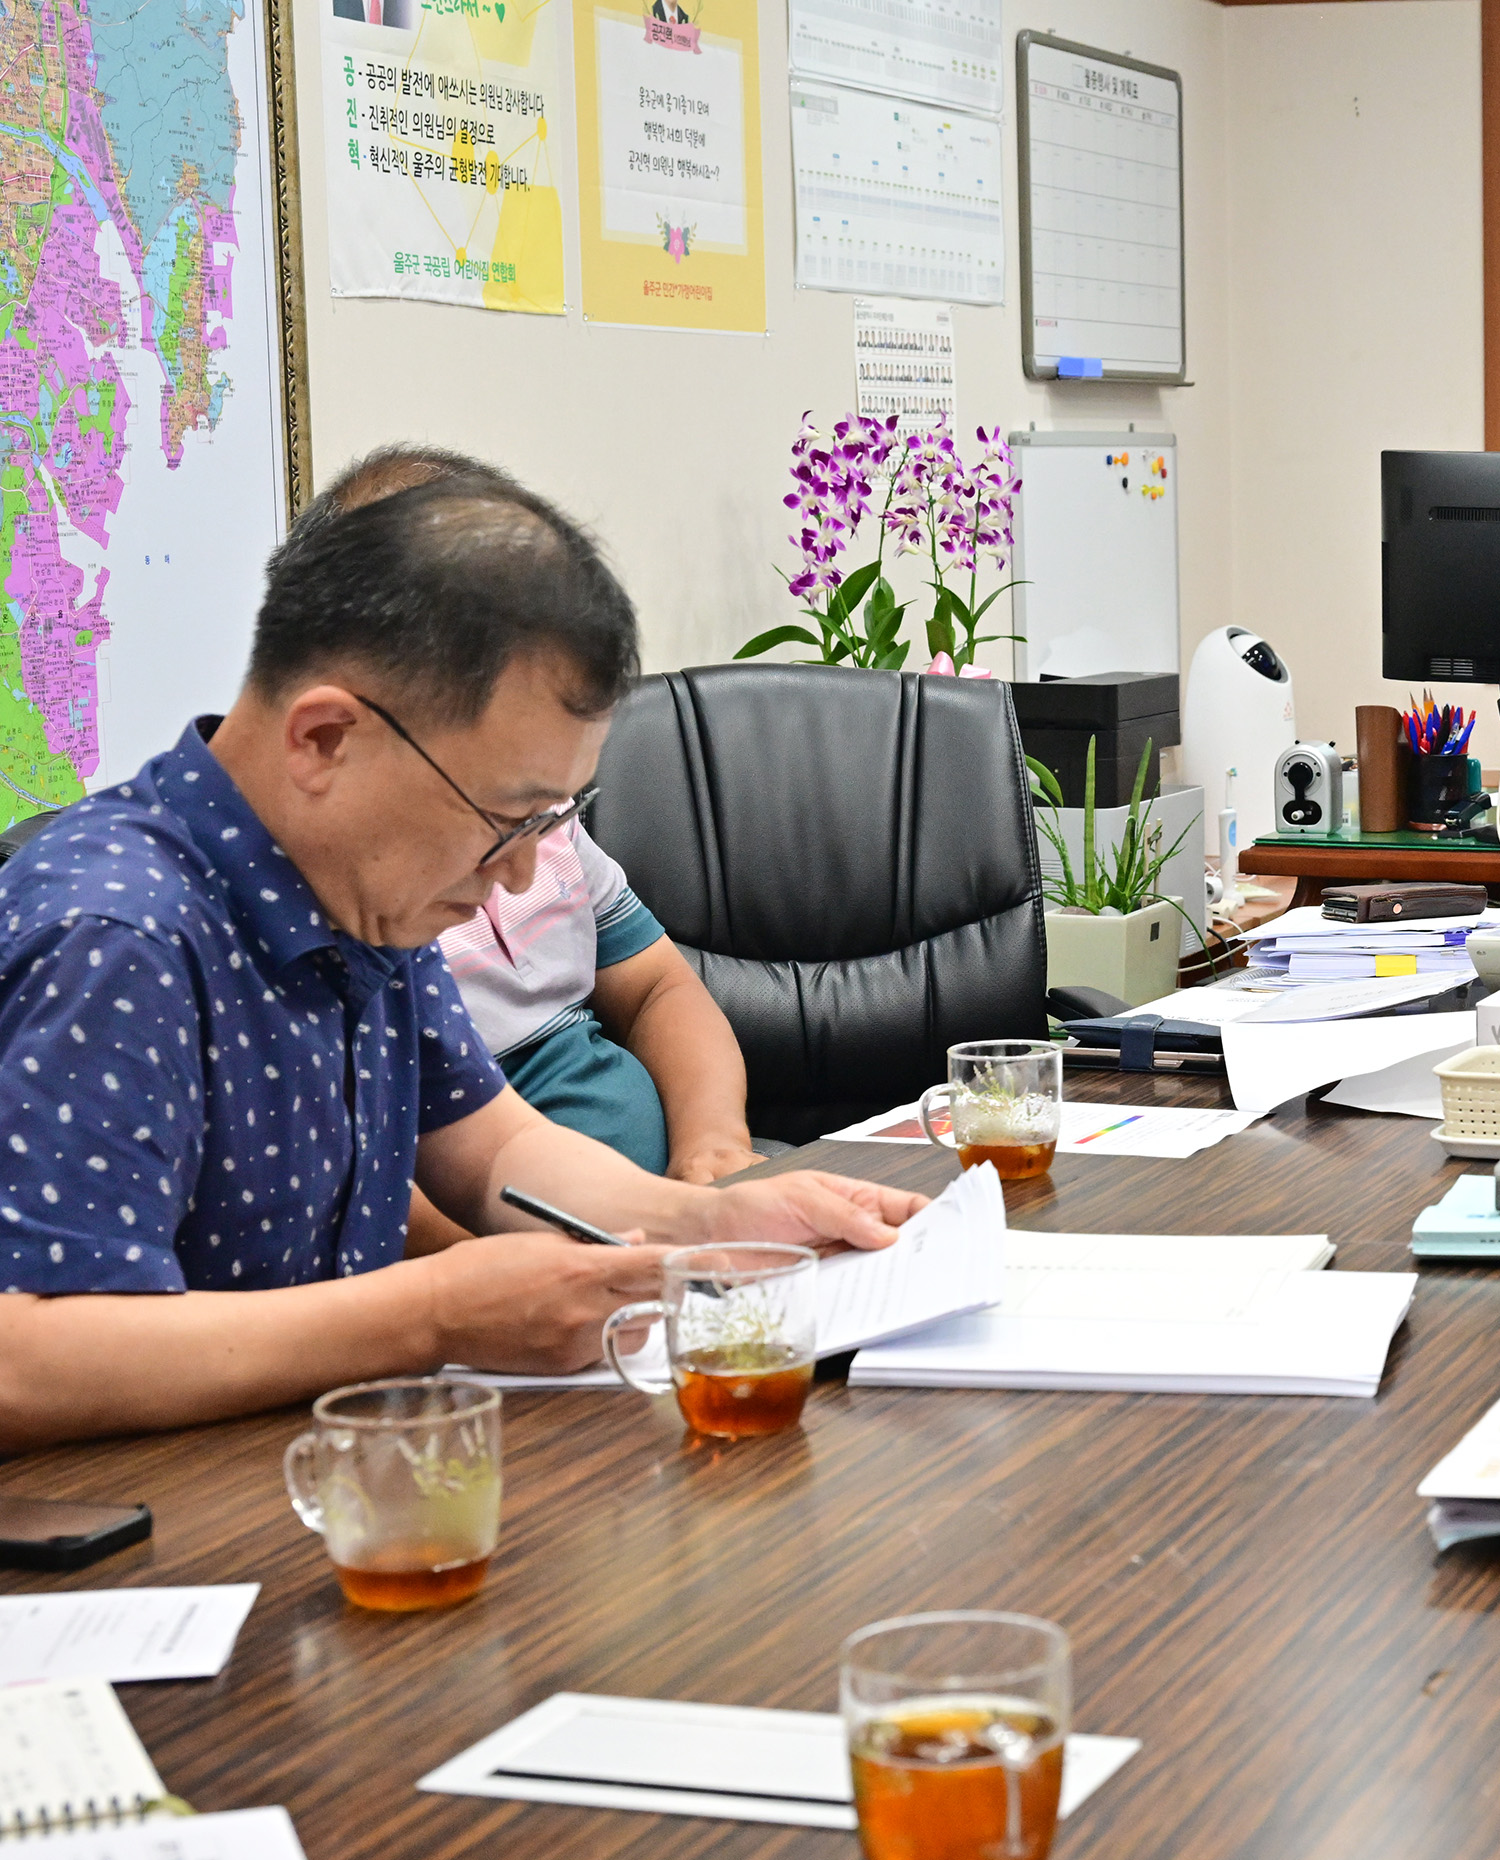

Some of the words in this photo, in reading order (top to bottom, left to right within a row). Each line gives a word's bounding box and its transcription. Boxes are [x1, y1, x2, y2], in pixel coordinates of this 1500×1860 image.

[651, 23, 673, 44] 공진혁
[343, 55, 355, 87] 공
[365, 63, 397, 93] 공공의
[401, 68, 435, 99] 발전에
[438, 76, 477, 106] 애쓰시는
[479, 83, 503, 111] 의원님
[504, 88, 544, 118] 감사합니다
[639, 86, 664, 110] 울주군에
[697, 101, 710, 116] 모여
[346, 98, 358, 129] 진
[368, 105, 409, 136] 진취적인
[412, 112, 456, 142] 의원님의
[460, 117, 495, 146] 열정으로
[643, 121, 665, 143] 행복한
[667, 127, 683, 143] 저희
[685, 128, 706, 149] 덕분에
[347, 138, 360, 171] 혁
[370, 145, 408, 176] 혁신적인
[413, 151, 445, 181] 울주의
[448, 157, 487, 186] 균형발전
[489, 163, 531, 192] 기대합니다.
[628, 150, 650, 173] 공진혁
[653, 155, 674, 177] 의원님
[393, 251, 420, 275] 울주군
[423, 255, 450, 278] 국공립
[454, 259, 489, 282] 어린이집
[491, 262, 516, 283] 연합회
